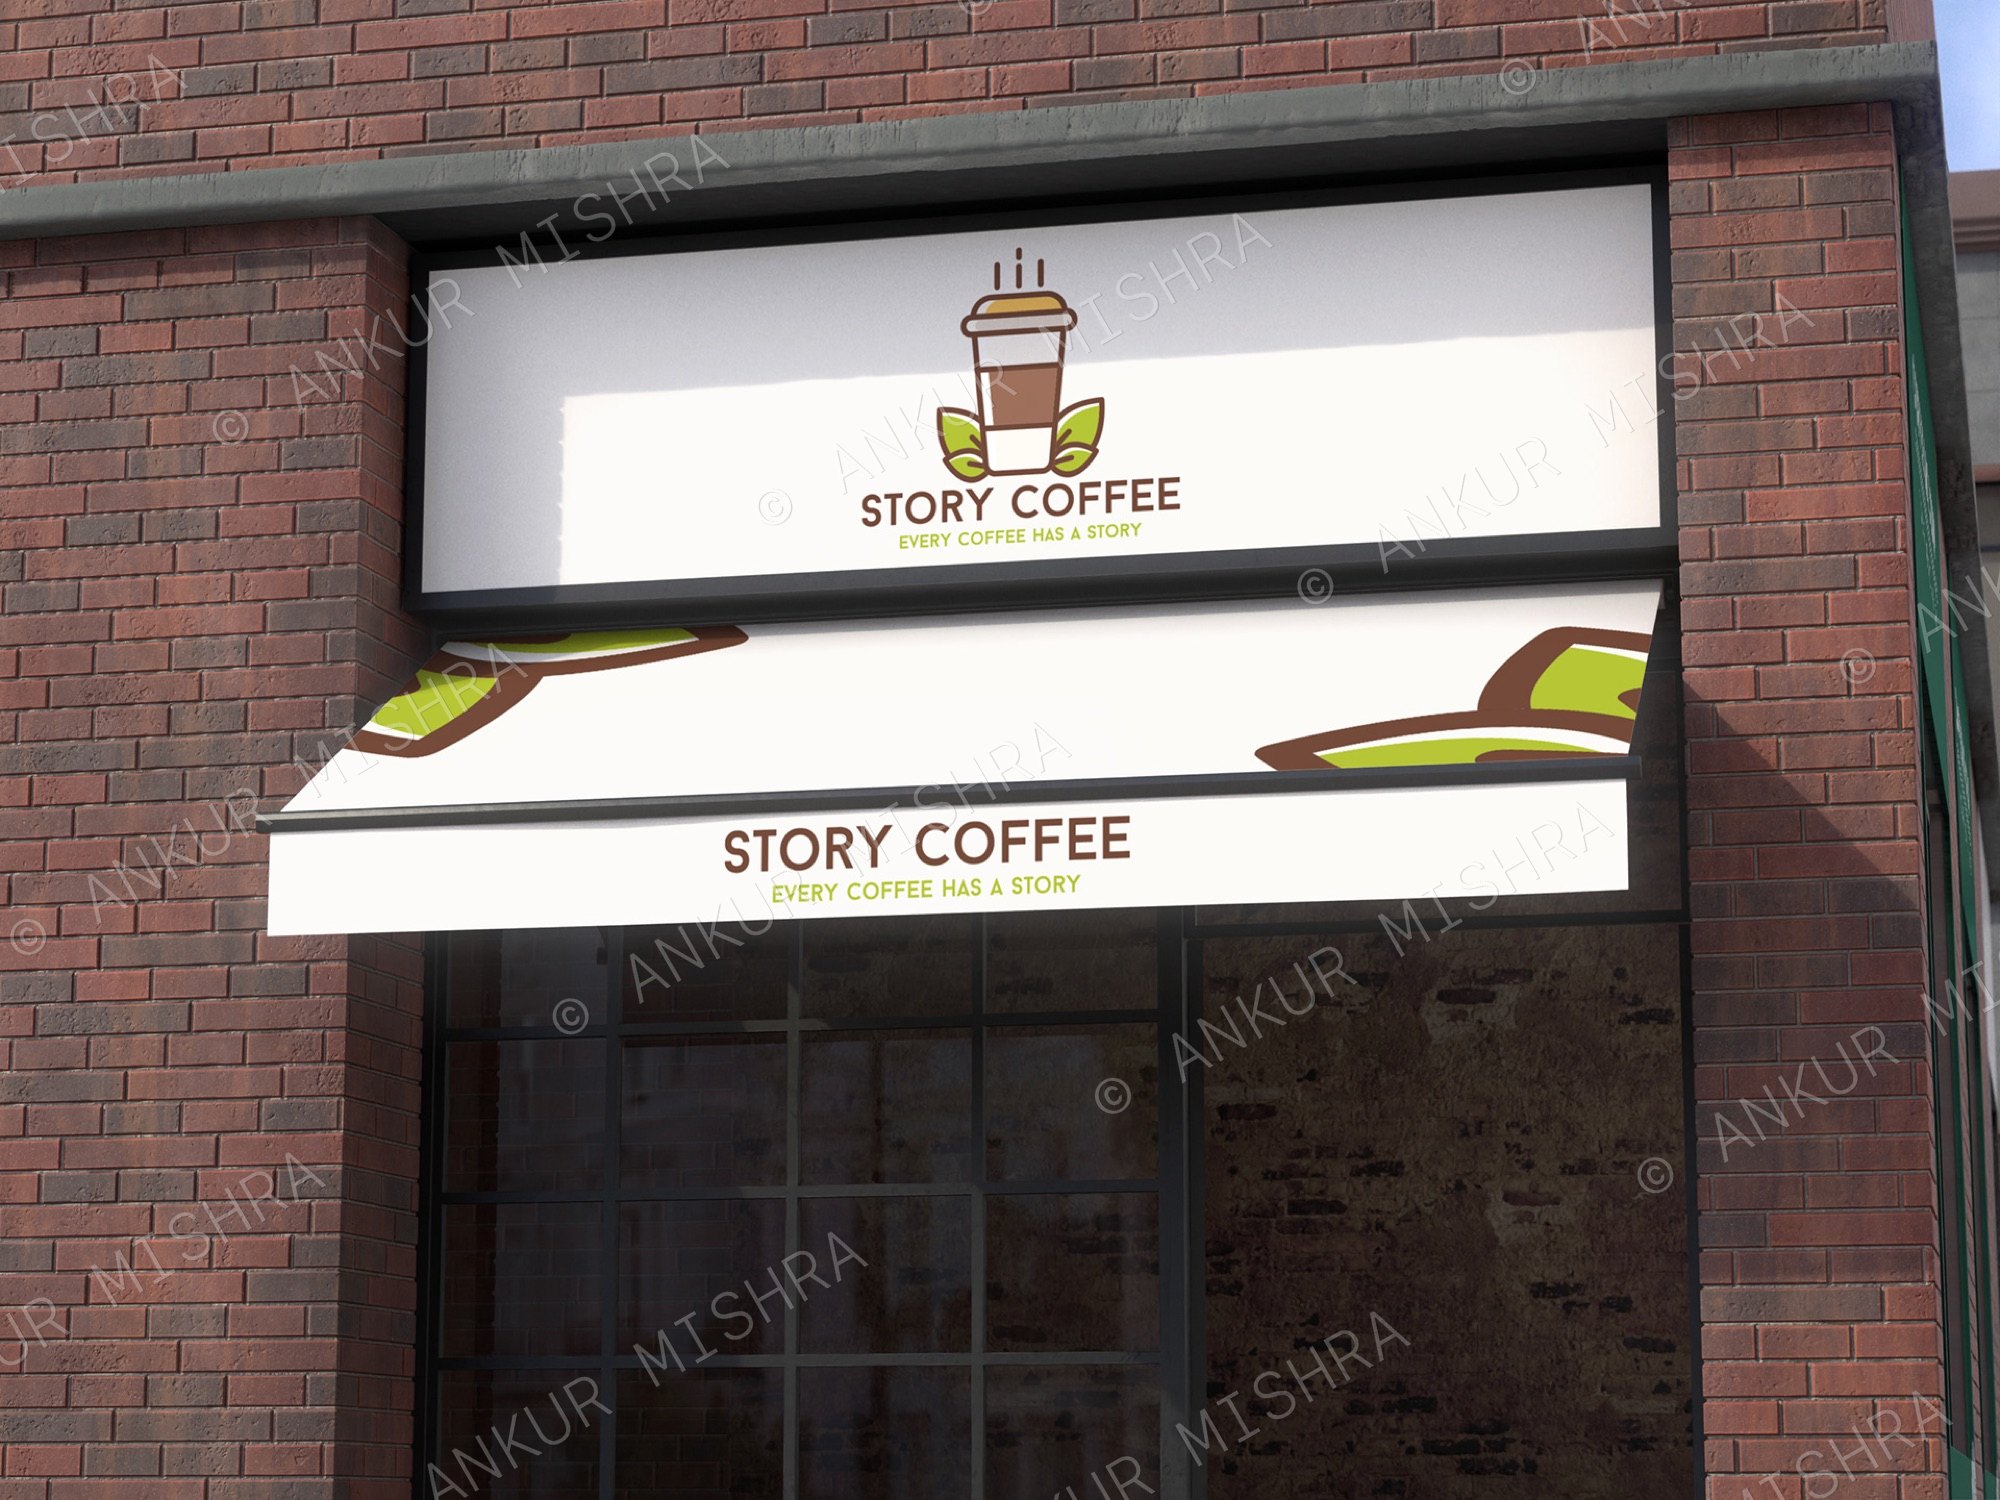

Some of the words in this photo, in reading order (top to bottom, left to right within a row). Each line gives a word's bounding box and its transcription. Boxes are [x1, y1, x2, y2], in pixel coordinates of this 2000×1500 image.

[861, 487, 994, 527] STORY
[1011, 477, 1180, 518] COFFEE
[899, 533, 951, 549] EVERY
[958, 529, 1026, 546] COFFEE
[1033, 527, 1064, 542] HAS
[1070, 527, 1080, 540] A
[1087, 523, 1142, 539] STORY
[724, 825, 892, 873] STORY
[916, 816, 1130, 866] COFFEE
[772, 883, 838, 903] EVERY
[847, 880, 933, 900] COFFEE
[943, 878, 982, 897] HAS
[990, 878, 1003, 895] A
[1012, 874, 1081, 894] STORY
